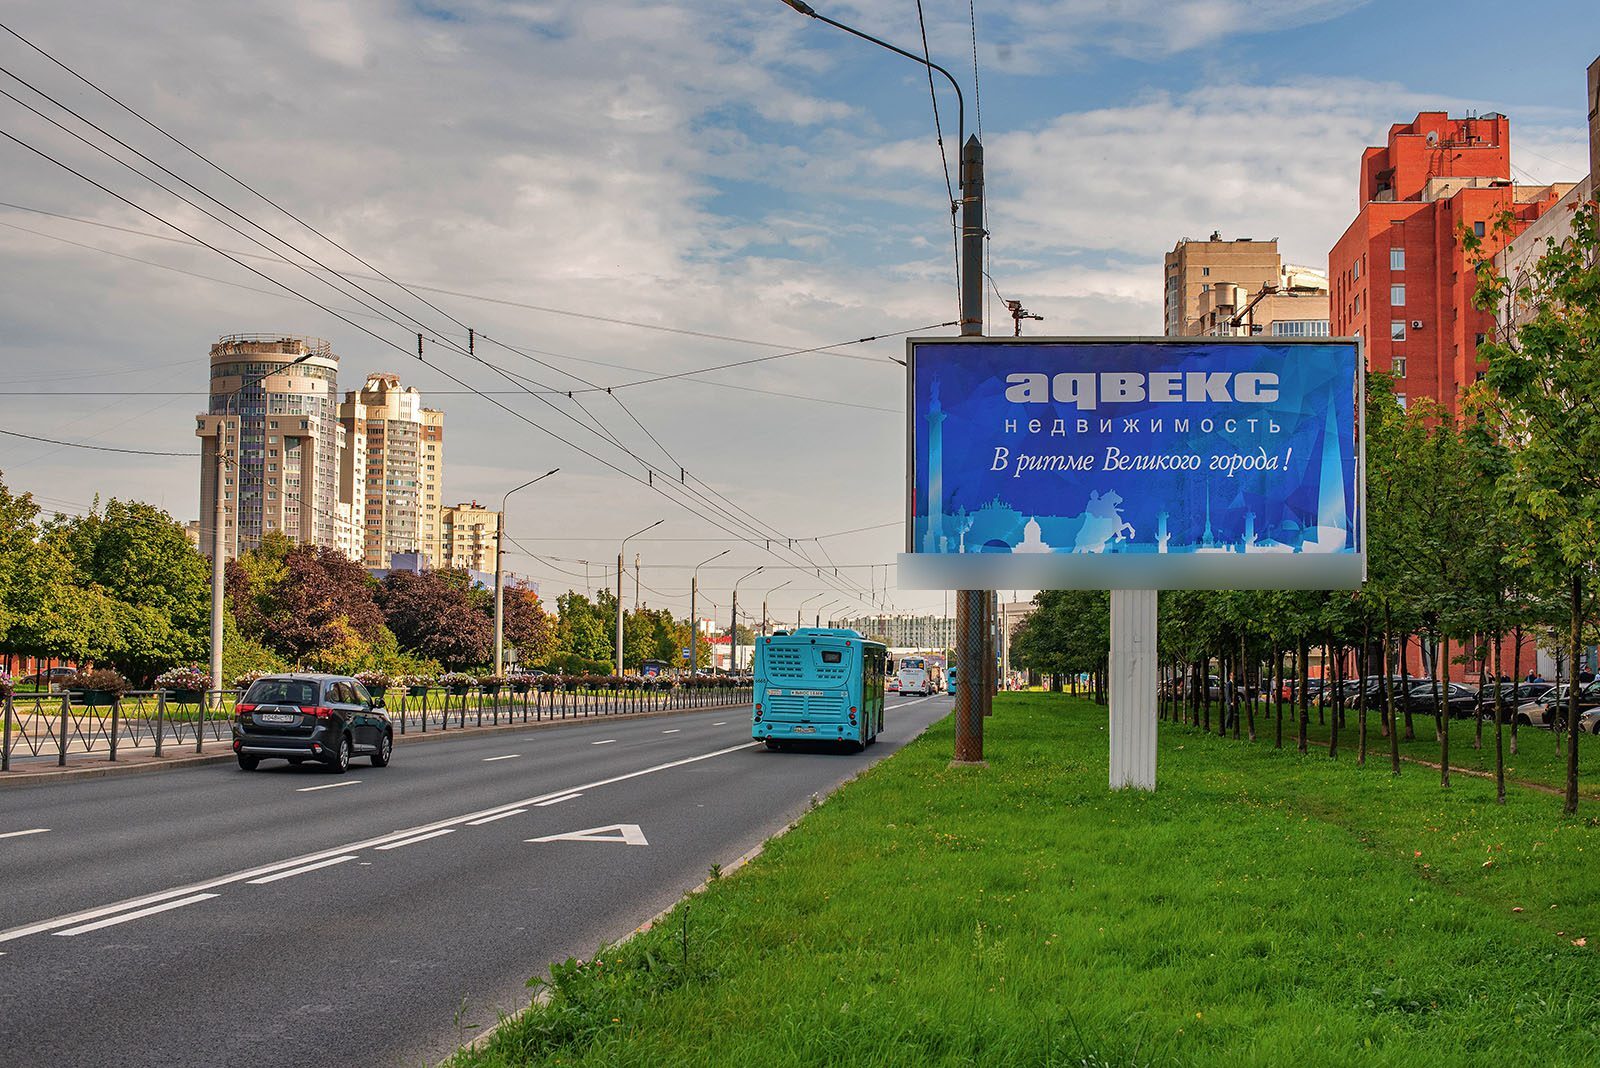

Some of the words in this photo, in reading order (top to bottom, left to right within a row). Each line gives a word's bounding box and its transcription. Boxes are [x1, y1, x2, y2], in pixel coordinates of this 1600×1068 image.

[1005, 418, 1281, 437] недвижимость
[990, 446, 1010, 471] В
[1013, 453, 1095, 478] ритме
[1102, 446, 1201, 471] Великого
[1209, 446, 1293, 477] города!
